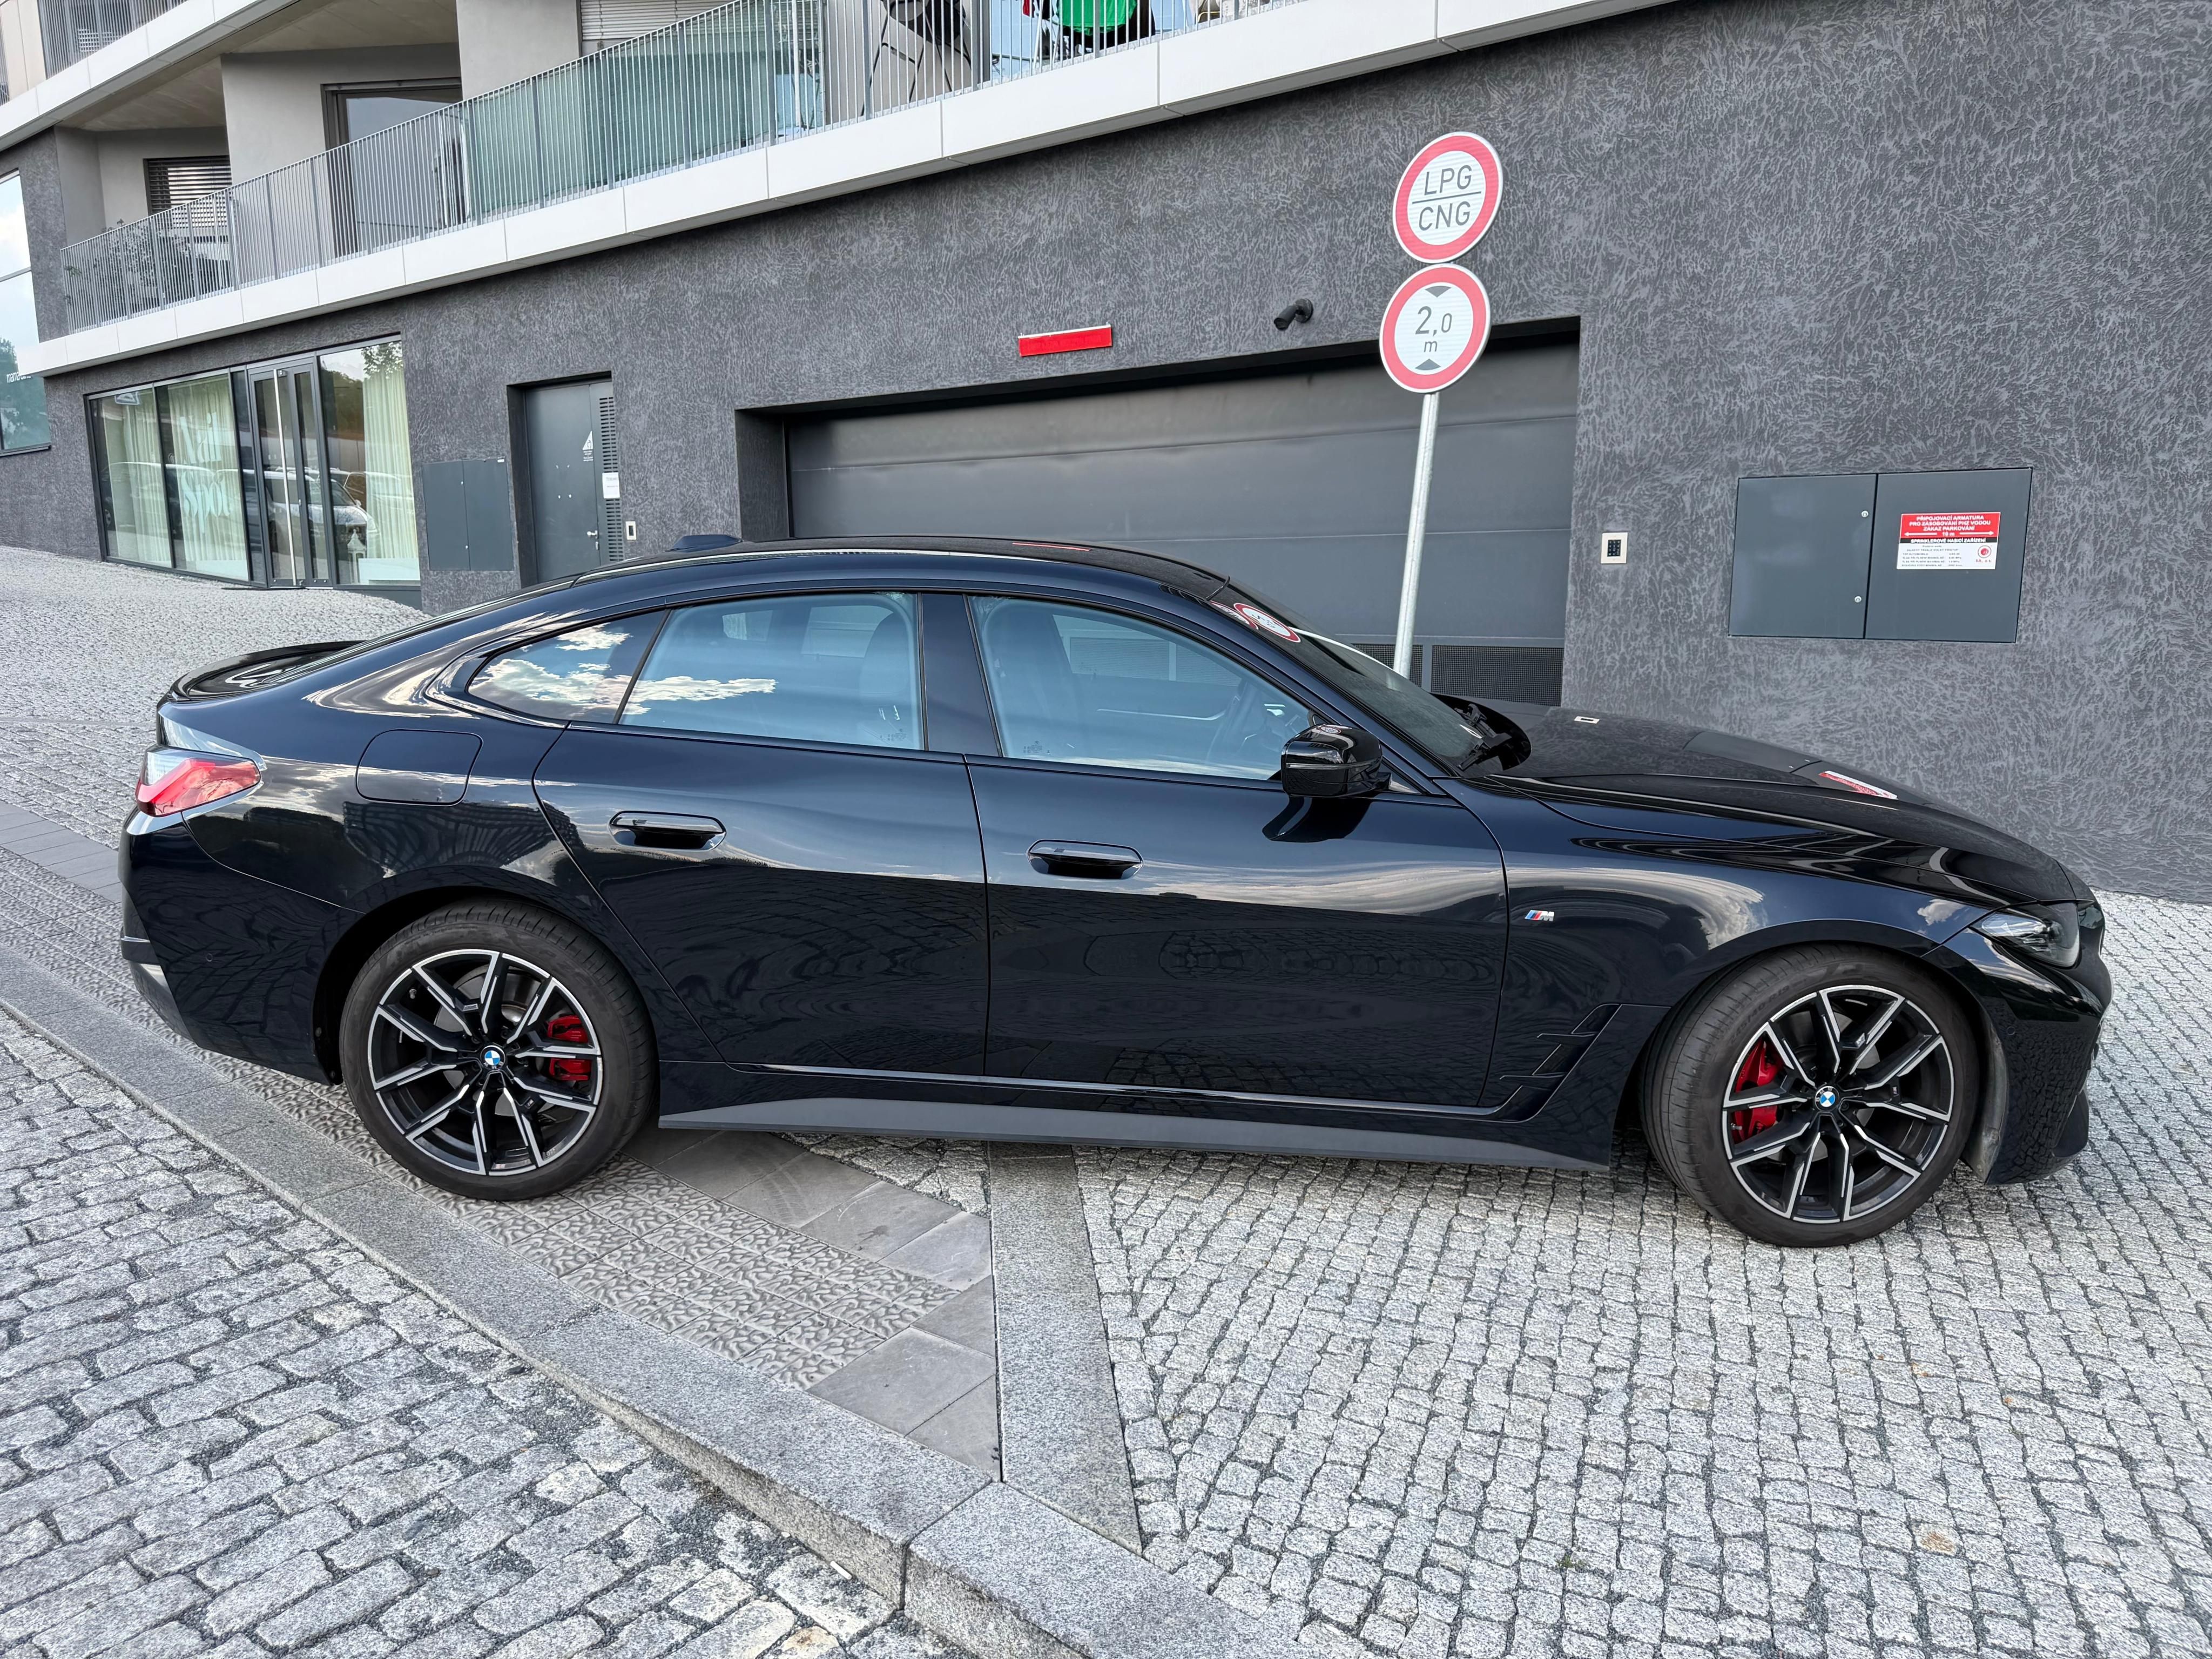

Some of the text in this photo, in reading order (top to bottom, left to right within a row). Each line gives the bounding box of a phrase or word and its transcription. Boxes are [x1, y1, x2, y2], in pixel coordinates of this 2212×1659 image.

[1424, 165, 1472, 196] LPG
[1419, 201, 1472, 231] CNG
[1415, 306, 1453, 337] 2,0
[1424, 340, 1438, 353] m
